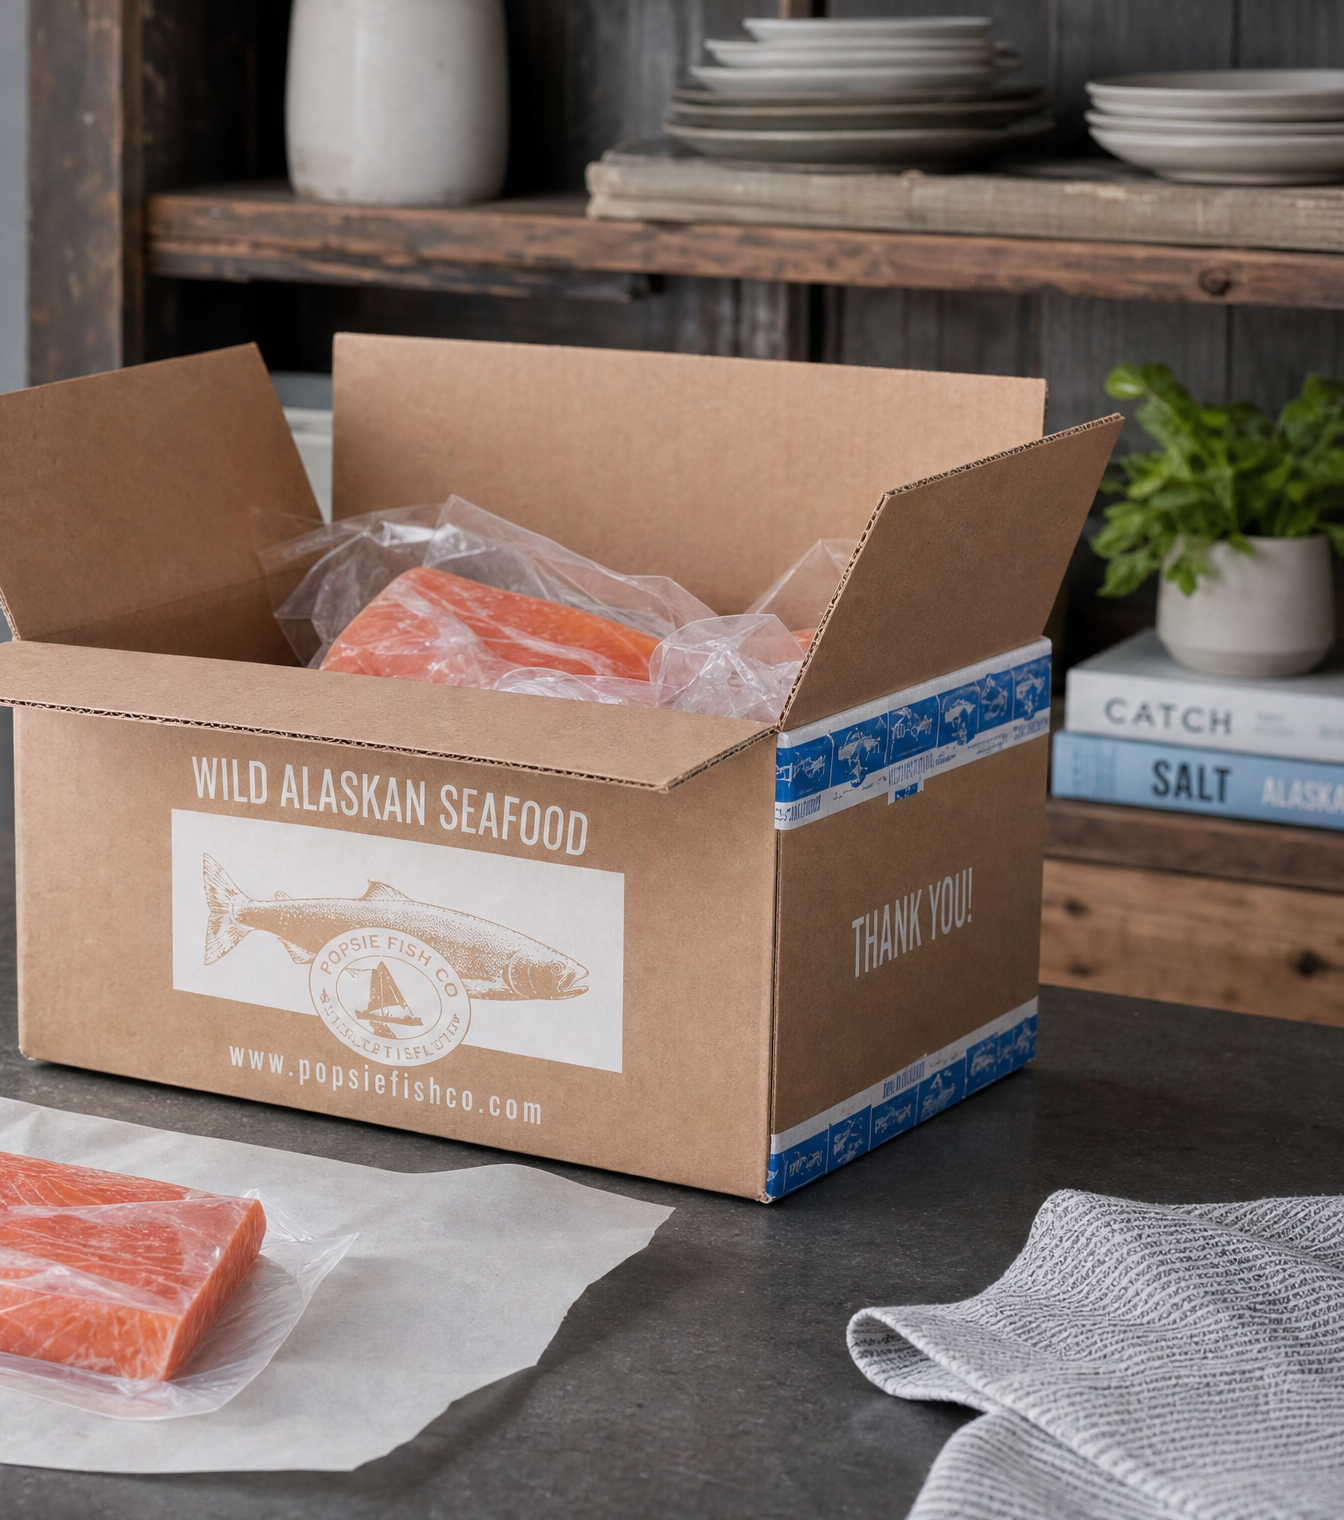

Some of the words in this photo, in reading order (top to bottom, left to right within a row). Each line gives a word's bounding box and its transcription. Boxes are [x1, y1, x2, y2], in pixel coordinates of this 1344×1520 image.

[1105, 697, 1232, 736] CATCH
[191, 756, 268, 804] WILD
[280, 764, 427, 826] ALASKAN
[439, 784, 589, 856] SEAFOOD
[1152, 759, 1232, 804] SALT
[851, 888, 923, 978] THANK
[928, 866, 973, 941] YOU!
[319, 934, 381, 976] POPSIE
[387, 935, 433, 967] FISH
[435, 967, 459, 998] CO
[228, 1045, 543, 1126] www.popsiefishco.com
